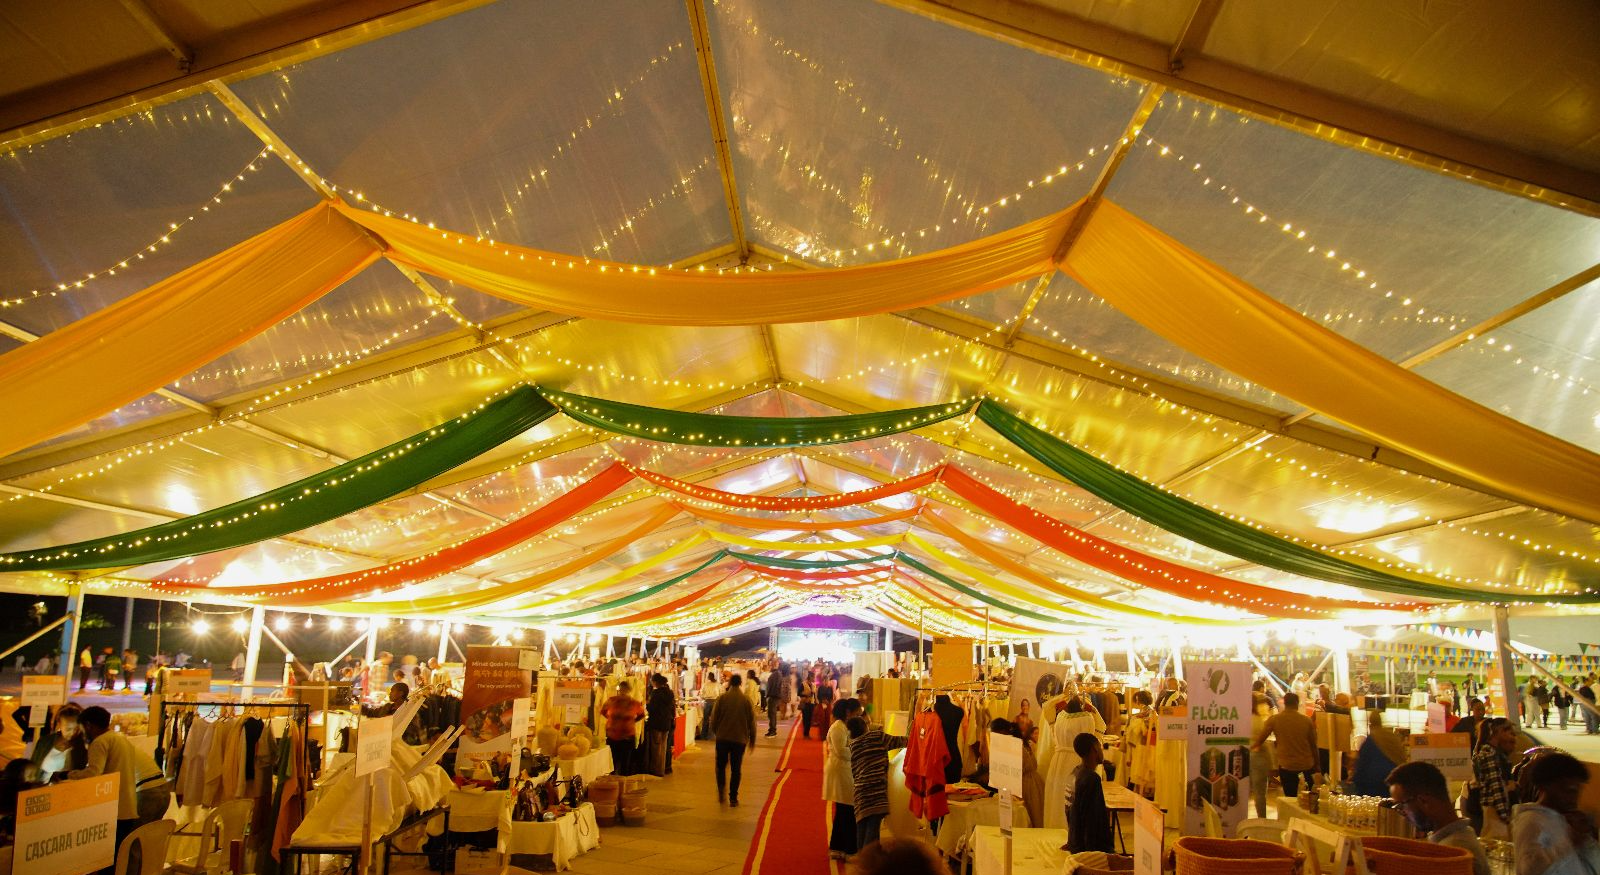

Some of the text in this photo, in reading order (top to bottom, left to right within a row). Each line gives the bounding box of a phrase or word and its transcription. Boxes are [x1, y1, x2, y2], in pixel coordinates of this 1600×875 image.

[1197, 724, 1219, 735] Hair
[1221, 724, 1234, 735] oil
[25, 823, 109, 862] CASCARA COFFEE
